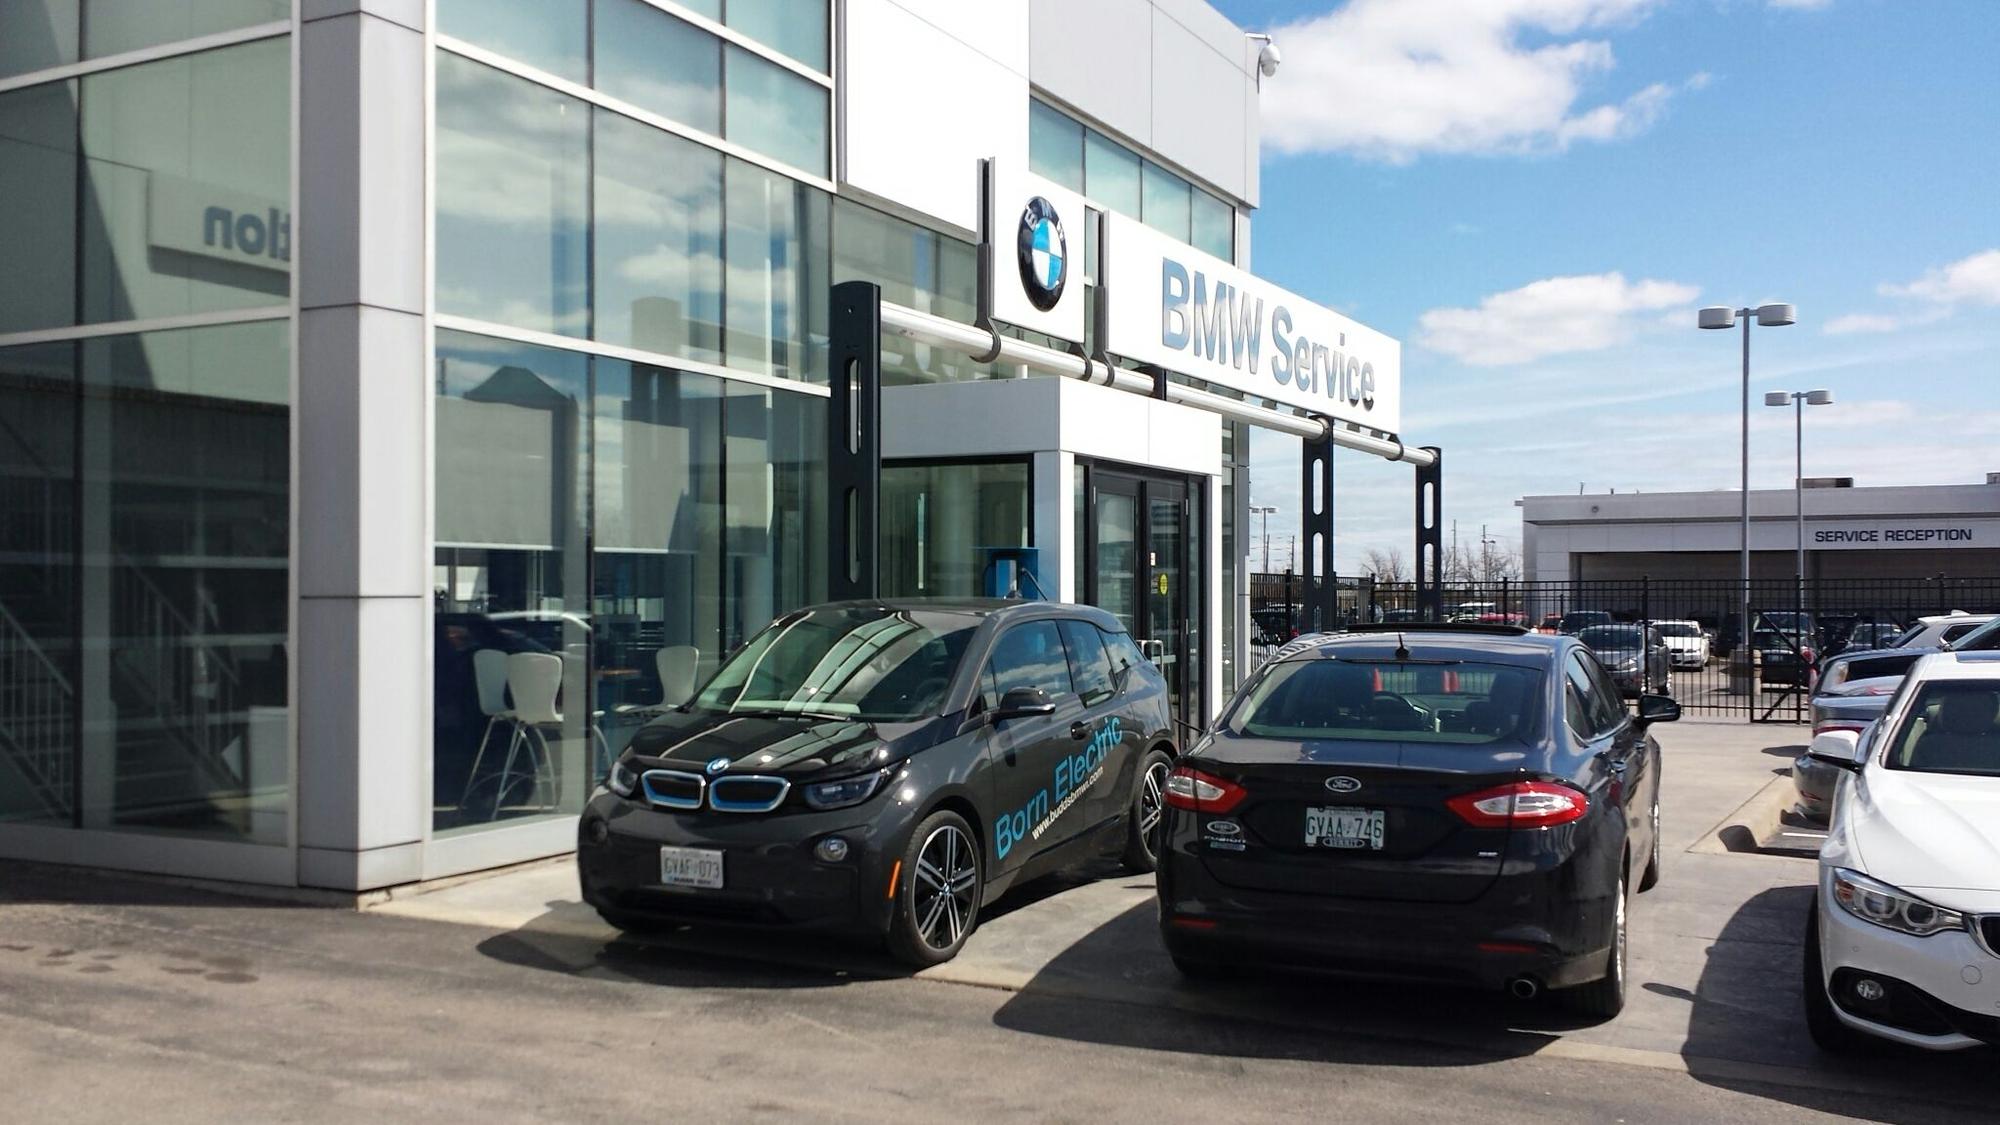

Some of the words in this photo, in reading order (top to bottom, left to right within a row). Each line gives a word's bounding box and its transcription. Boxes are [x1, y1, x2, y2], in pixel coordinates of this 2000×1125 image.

[1161, 256, 1264, 375] BMW
[1271, 305, 1375, 411] Service
[1815, 530, 1879, 543] SERVICE
[1884, 528, 1972, 542] RECEPTION
[995, 788, 1048, 860] Born
[1055, 717, 1122, 802] Electric
[1031, 766, 1104, 840] www.buddsbmw.com
